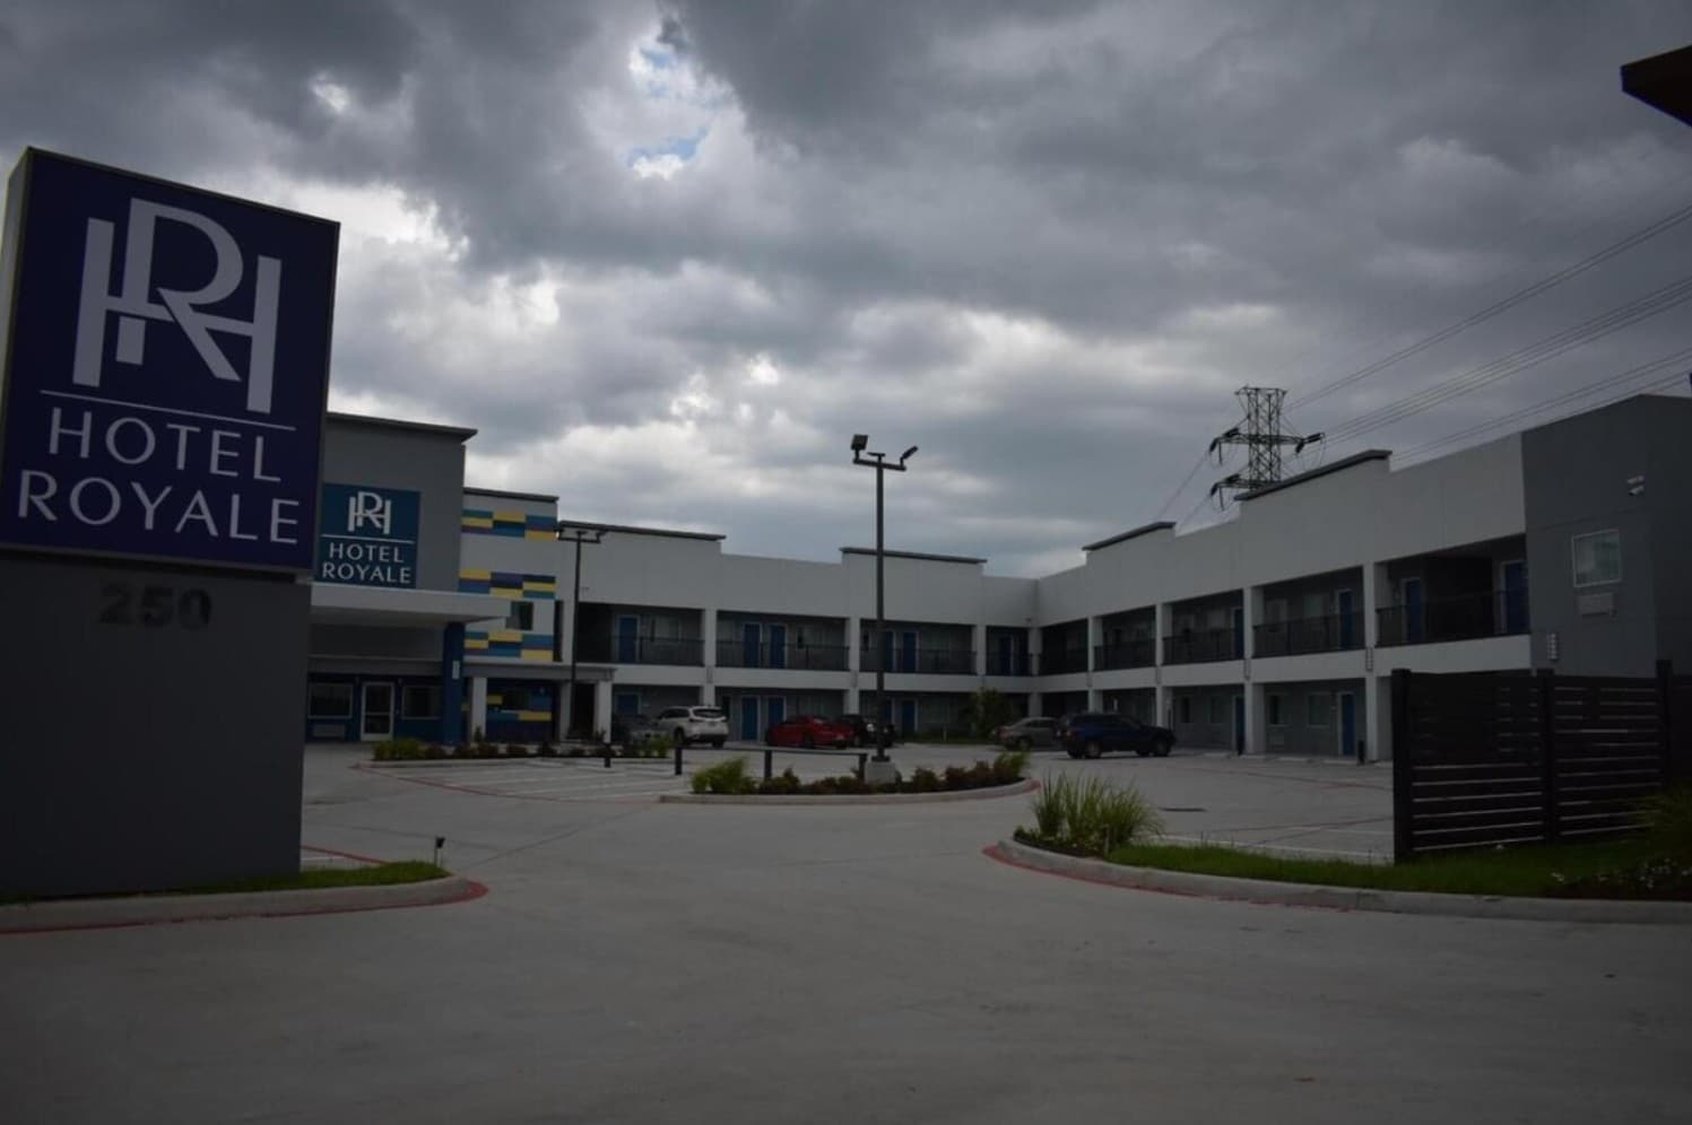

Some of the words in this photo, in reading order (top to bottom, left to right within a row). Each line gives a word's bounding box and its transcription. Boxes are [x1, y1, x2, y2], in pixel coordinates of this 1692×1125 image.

[48, 407, 282, 483] HOTEL
[17, 469, 300, 545] ROYALE
[321, 561, 412, 584] ROYALE
[329, 542, 405, 563] HOTEL
[99, 584, 212, 630] 250
